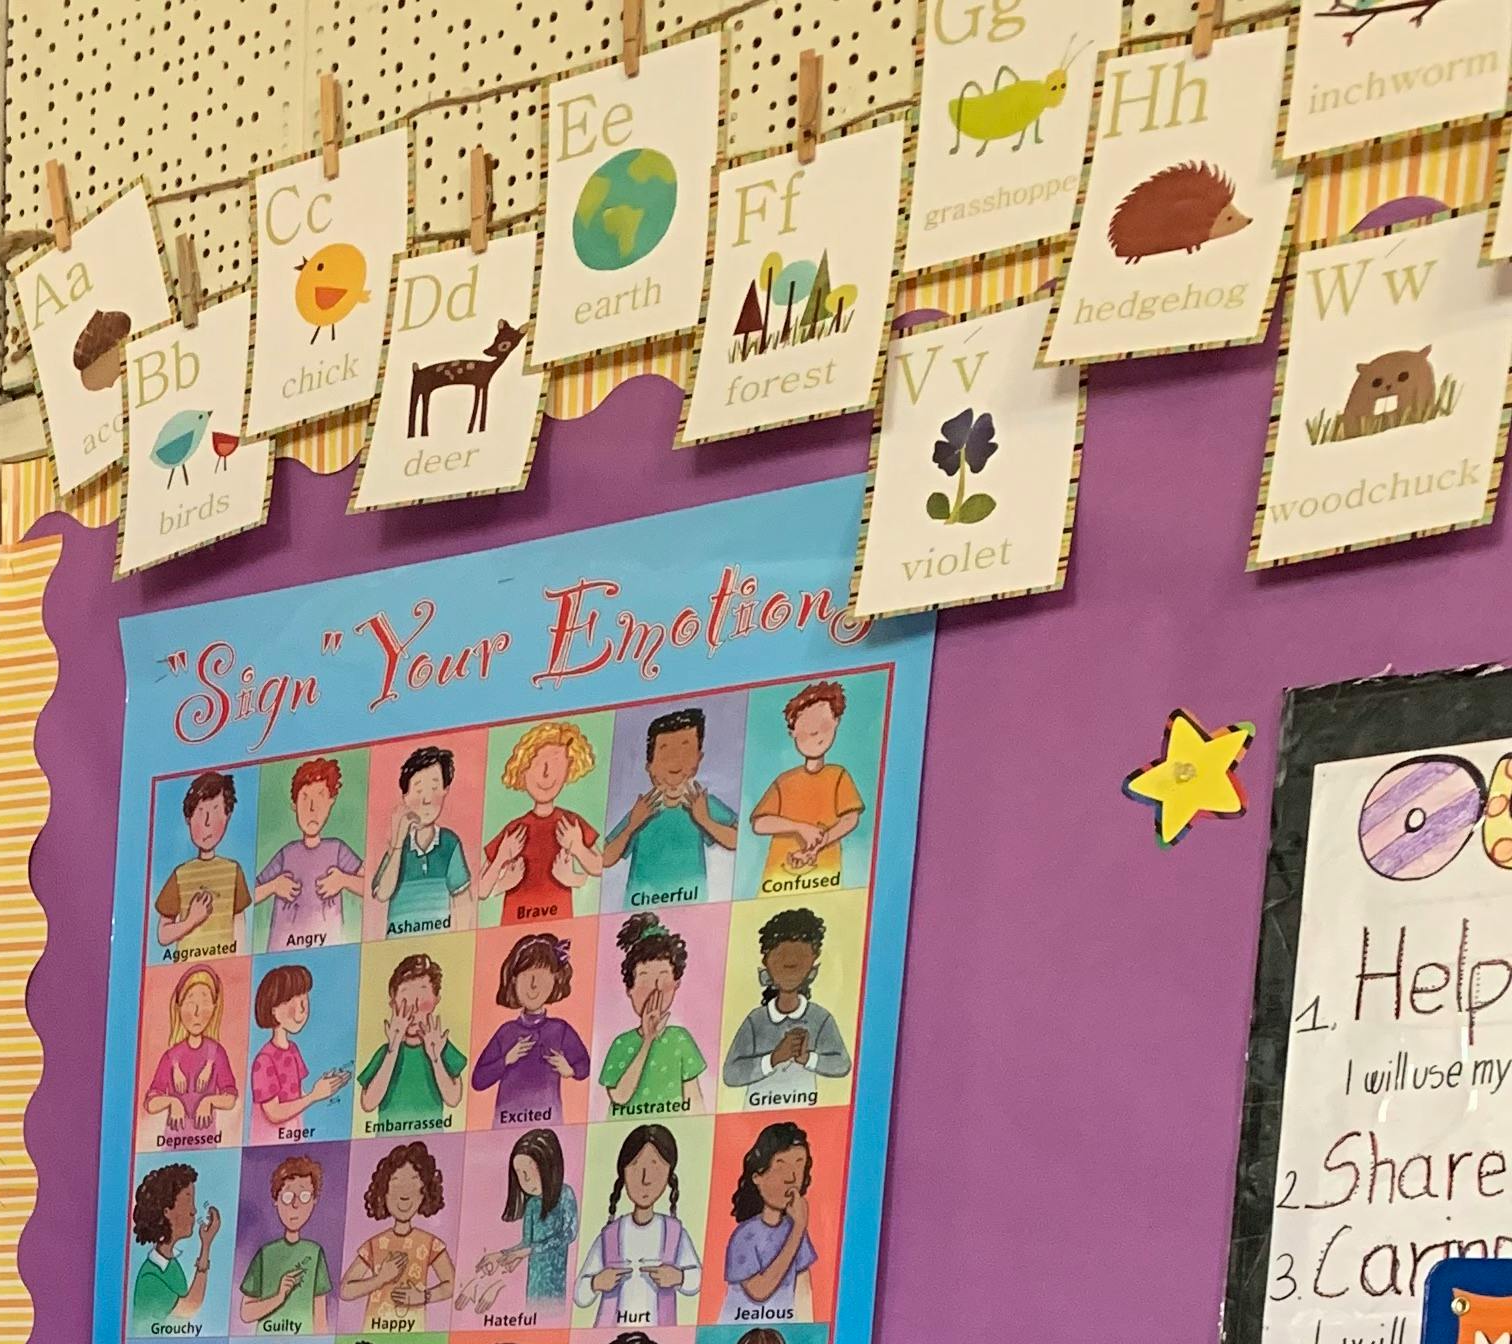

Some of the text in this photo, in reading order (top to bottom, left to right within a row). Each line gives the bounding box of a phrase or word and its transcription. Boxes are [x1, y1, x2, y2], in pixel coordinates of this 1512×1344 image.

[1103, 60, 1208, 139] Hh
[1308, 50, 1498, 115] inchworm
[556, 94, 633, 162] Ee
[263, 186, 333, 247] Cc
[735, 171, 805, 246] Ff
[924, 172, 1078, 231] grasshoppe
[32, 262, 93, 329] Aa
[397, 266, 480, 332] Dd
[574, 276, 662, 326] earth
[1074, 279, 1249, 326] hedgehog
[1308, 260, 1370, 320] W
[133, 344, 202, 408] Bb
[282, 352, 360, 401] chick
[725, 358, 837, 406] forest
[896, 346, 945, 406] V
[83, 413, 129, 455] aco
[404, 444, 480, 478] deer
[1268, 458, 1480, 525] woodchuck
[159, 492, 230, 536] birds
[901, 537, 1012, 582] violet
[355, 598, 513, 712] Your
[631, 887, 698, 906] Cheerful
[762, 872, 840, 894] Confused
[386, 916, 451, 936] Ashamed
[517, 903, 558, 919] Brave
[163, 941, 237, 961] Aggravated
[286, 932, 327, 948] Angry
[1355, 917, 1512, 1046] Help
[1365, 1052, 1408, 1092] will
[1412, 1054, 1463, 1090] use
[1471, 1058, 1512, 1097] my
[500, 1108, 552, 1124] Excited
[612, 1099, 691, 1117] Frustrated
[749, 1091, 818, 1108] Grieving
[156, 1132, 222, 1148] Depressed
[278, 1126, 316, 1141] Eager
[365, 1115, 452, 1134] Embarrassed
[1306, 1130, 1505, 1209] Share
[151, 1322, 203, 1337] Grouchy
[263, 1319, 302, 1334] Guilty
[371, 1317, 415, 1333] Happy
[483, 1312, 537, 1326] Hateful
[617, 1310, 651, 1324] Hurt
[734, 1306, 794, 1321] Jealous
